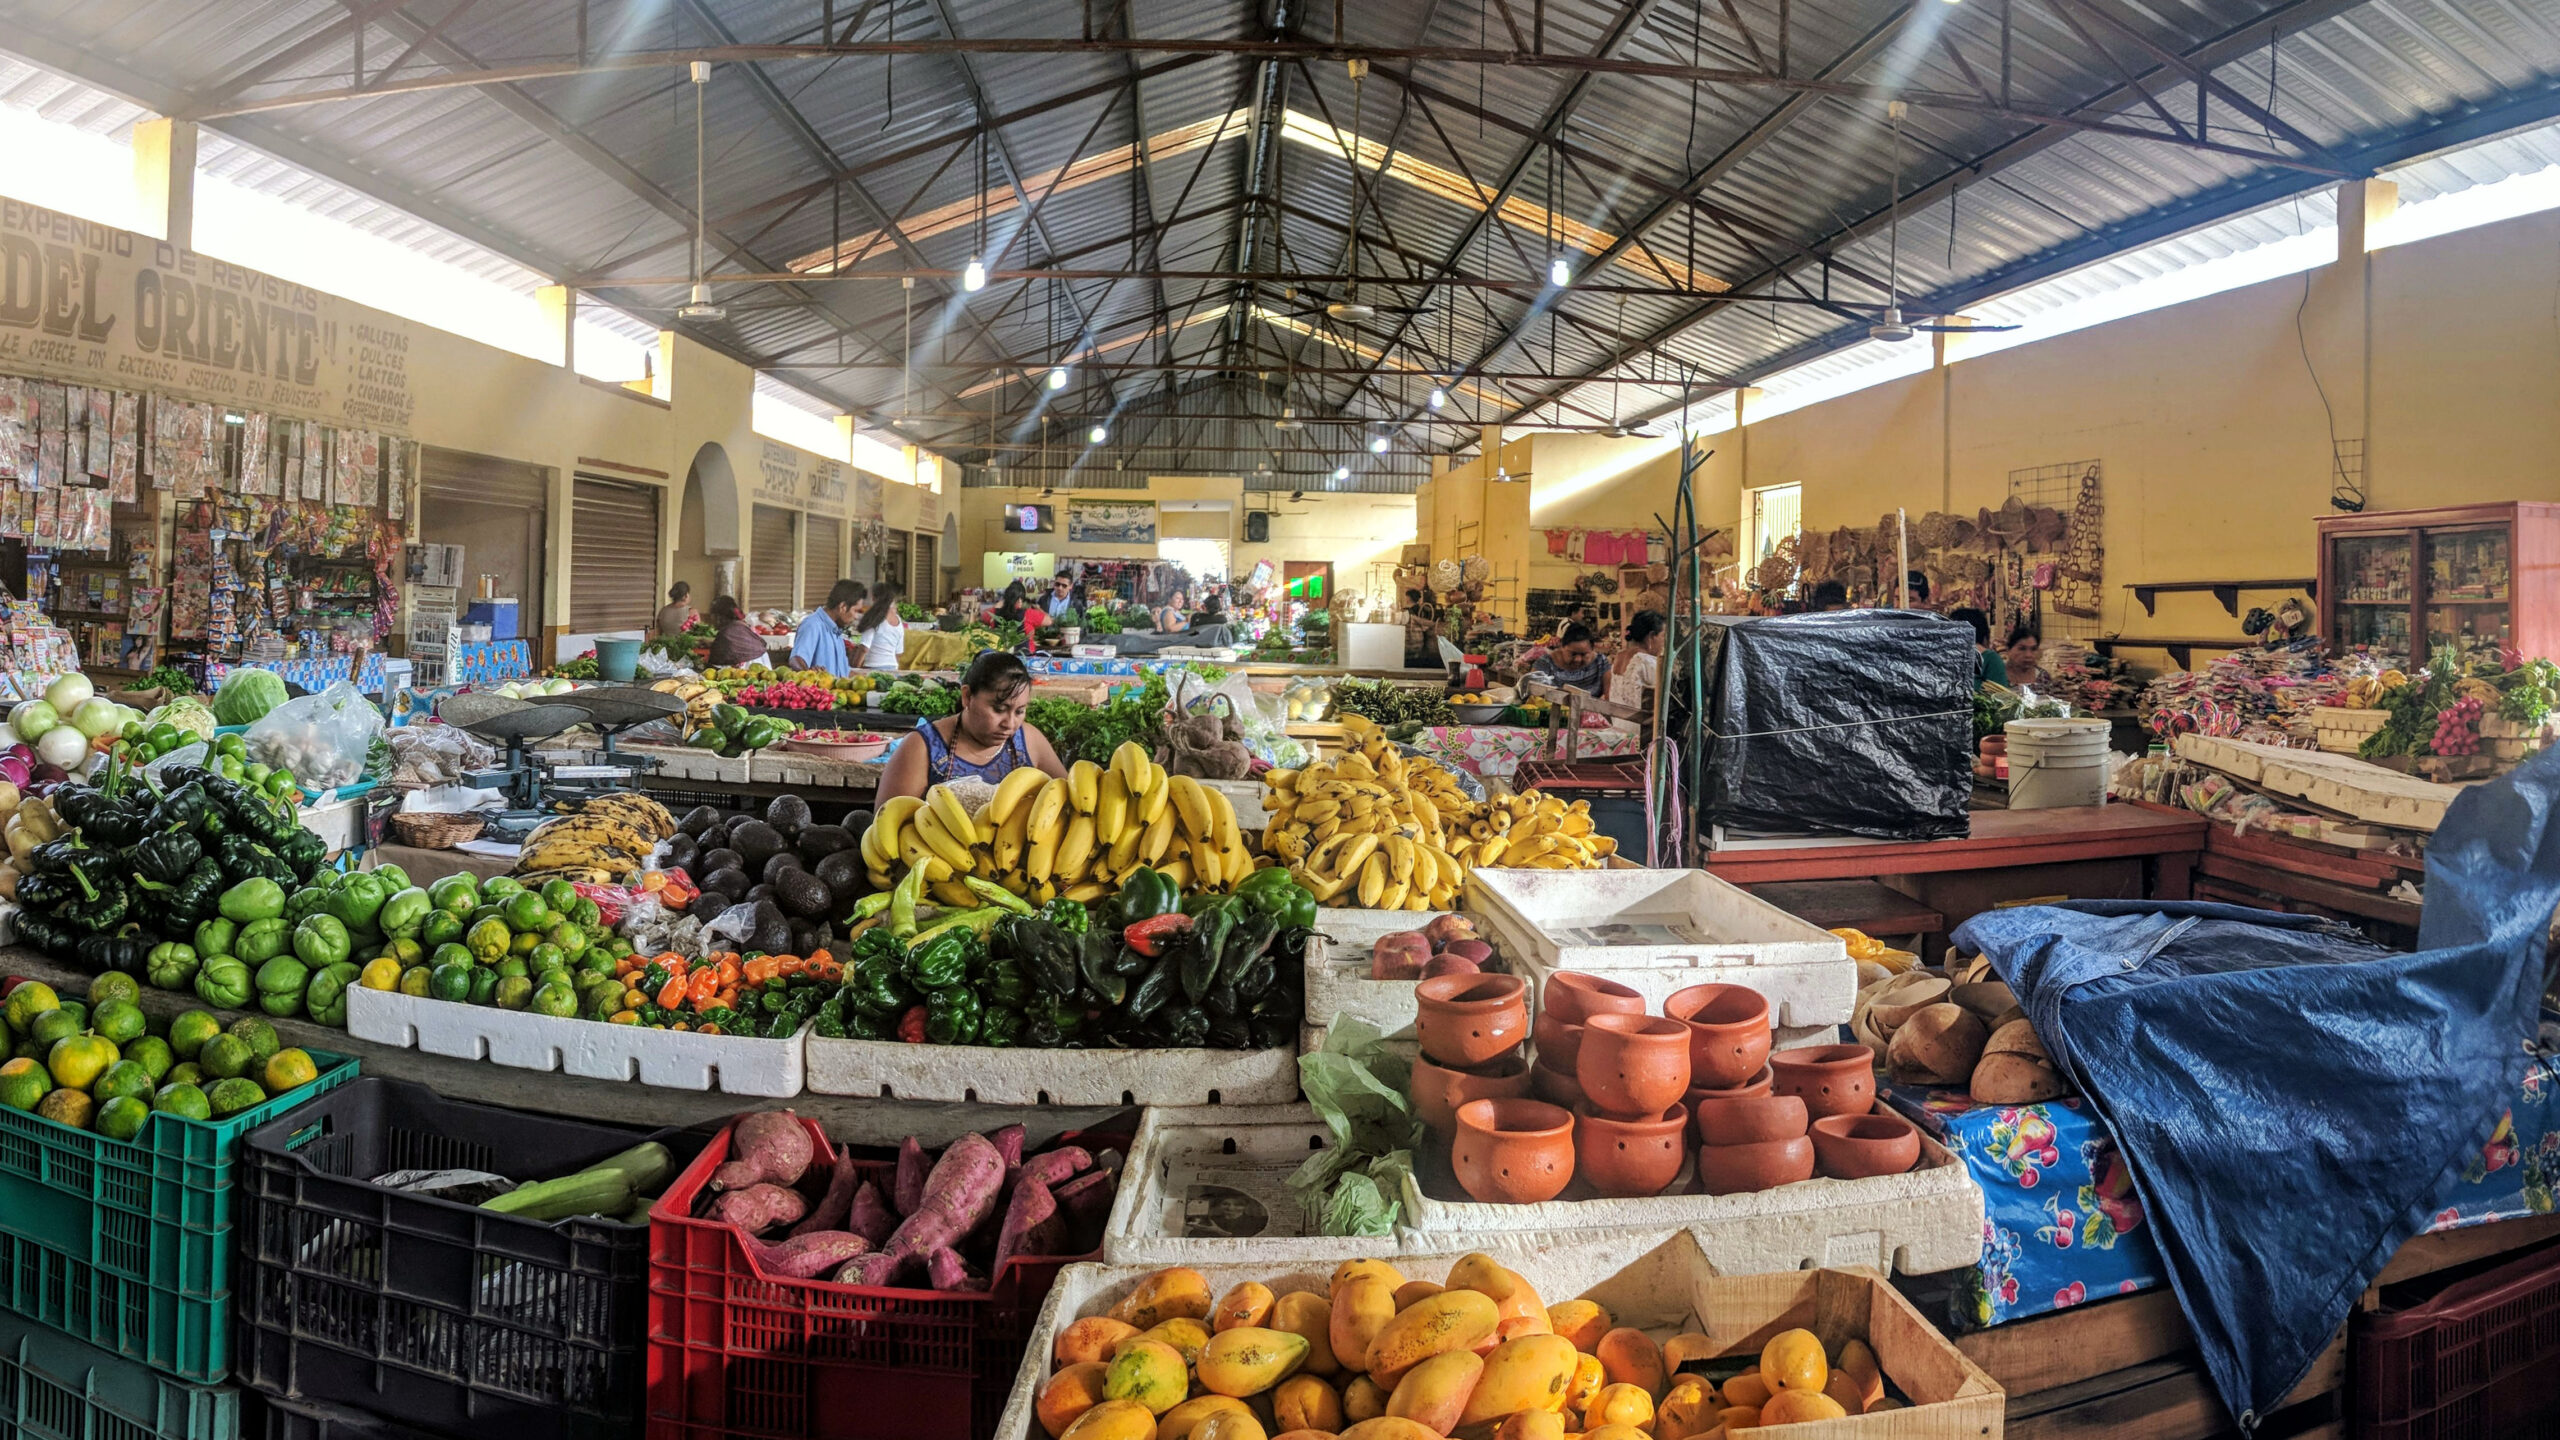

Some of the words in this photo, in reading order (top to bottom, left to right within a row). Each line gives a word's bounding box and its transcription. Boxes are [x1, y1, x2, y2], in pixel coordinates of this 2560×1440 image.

[3, 198, 132, 258] EXPENDIO
[156, 241, 197, 277] DE
[212, 259, 317, 311] REVISTAS
[0, 231, 116, 344] DEL
[357, 324, 409, 353] GALLETAS
[1, 332, 20, 354] LE
[29, 339, 77, 365] OFRECE
[87, 349, 107, 369] UN
[118, 354, 178, 381] EXTENSO
[186, 368, 238, 394] SURTIDO
[246, 380, 266, 398] EN
[272, 383, 322, 409] REVISTAS
[360, 346, 405, 371] DULCES
[358, 365, 407, 389] LACTEOS
[357, 383, 406, 409] CIGARROS
